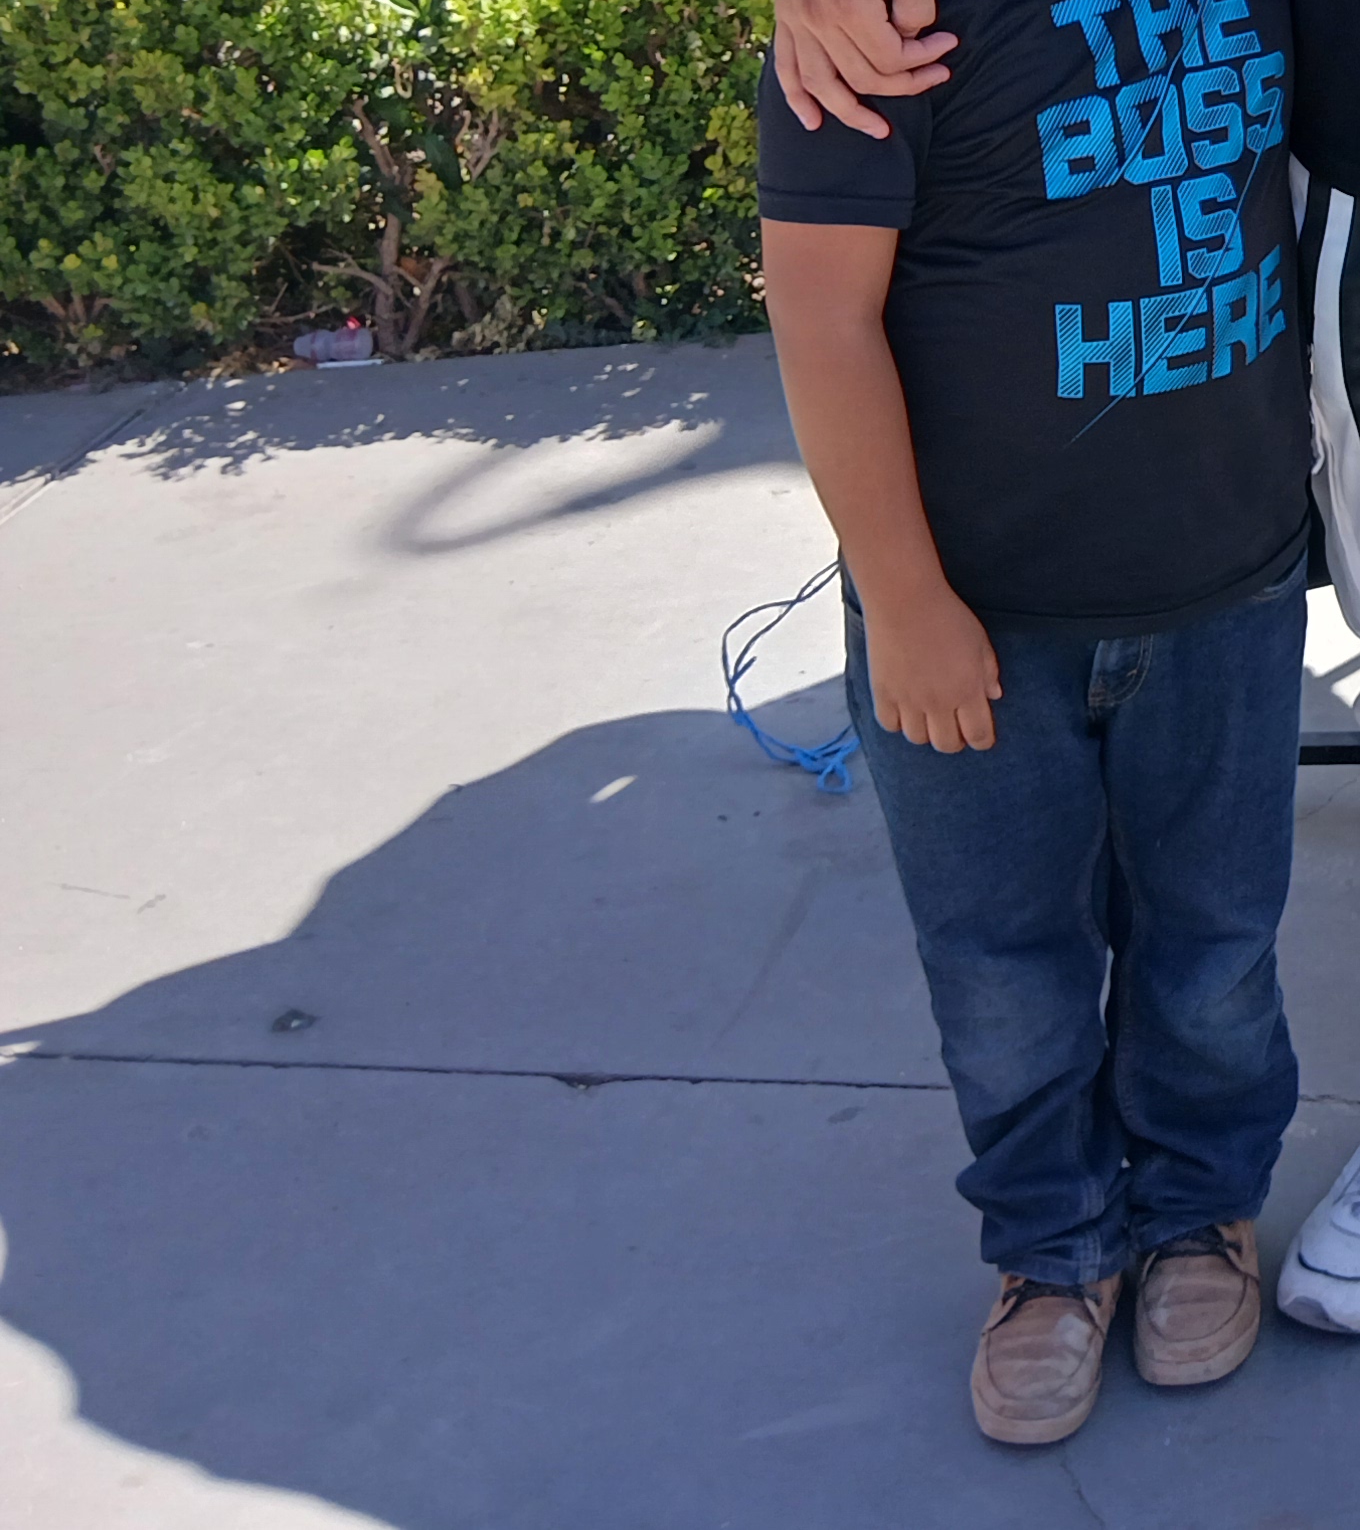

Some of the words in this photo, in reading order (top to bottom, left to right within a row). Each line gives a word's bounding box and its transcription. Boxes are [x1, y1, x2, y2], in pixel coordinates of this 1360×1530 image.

[1037, 52, 1285, 200] BOSS
[1151, 172, 1244, 287] IS
[1055, 244, 1286, 399] HERE
